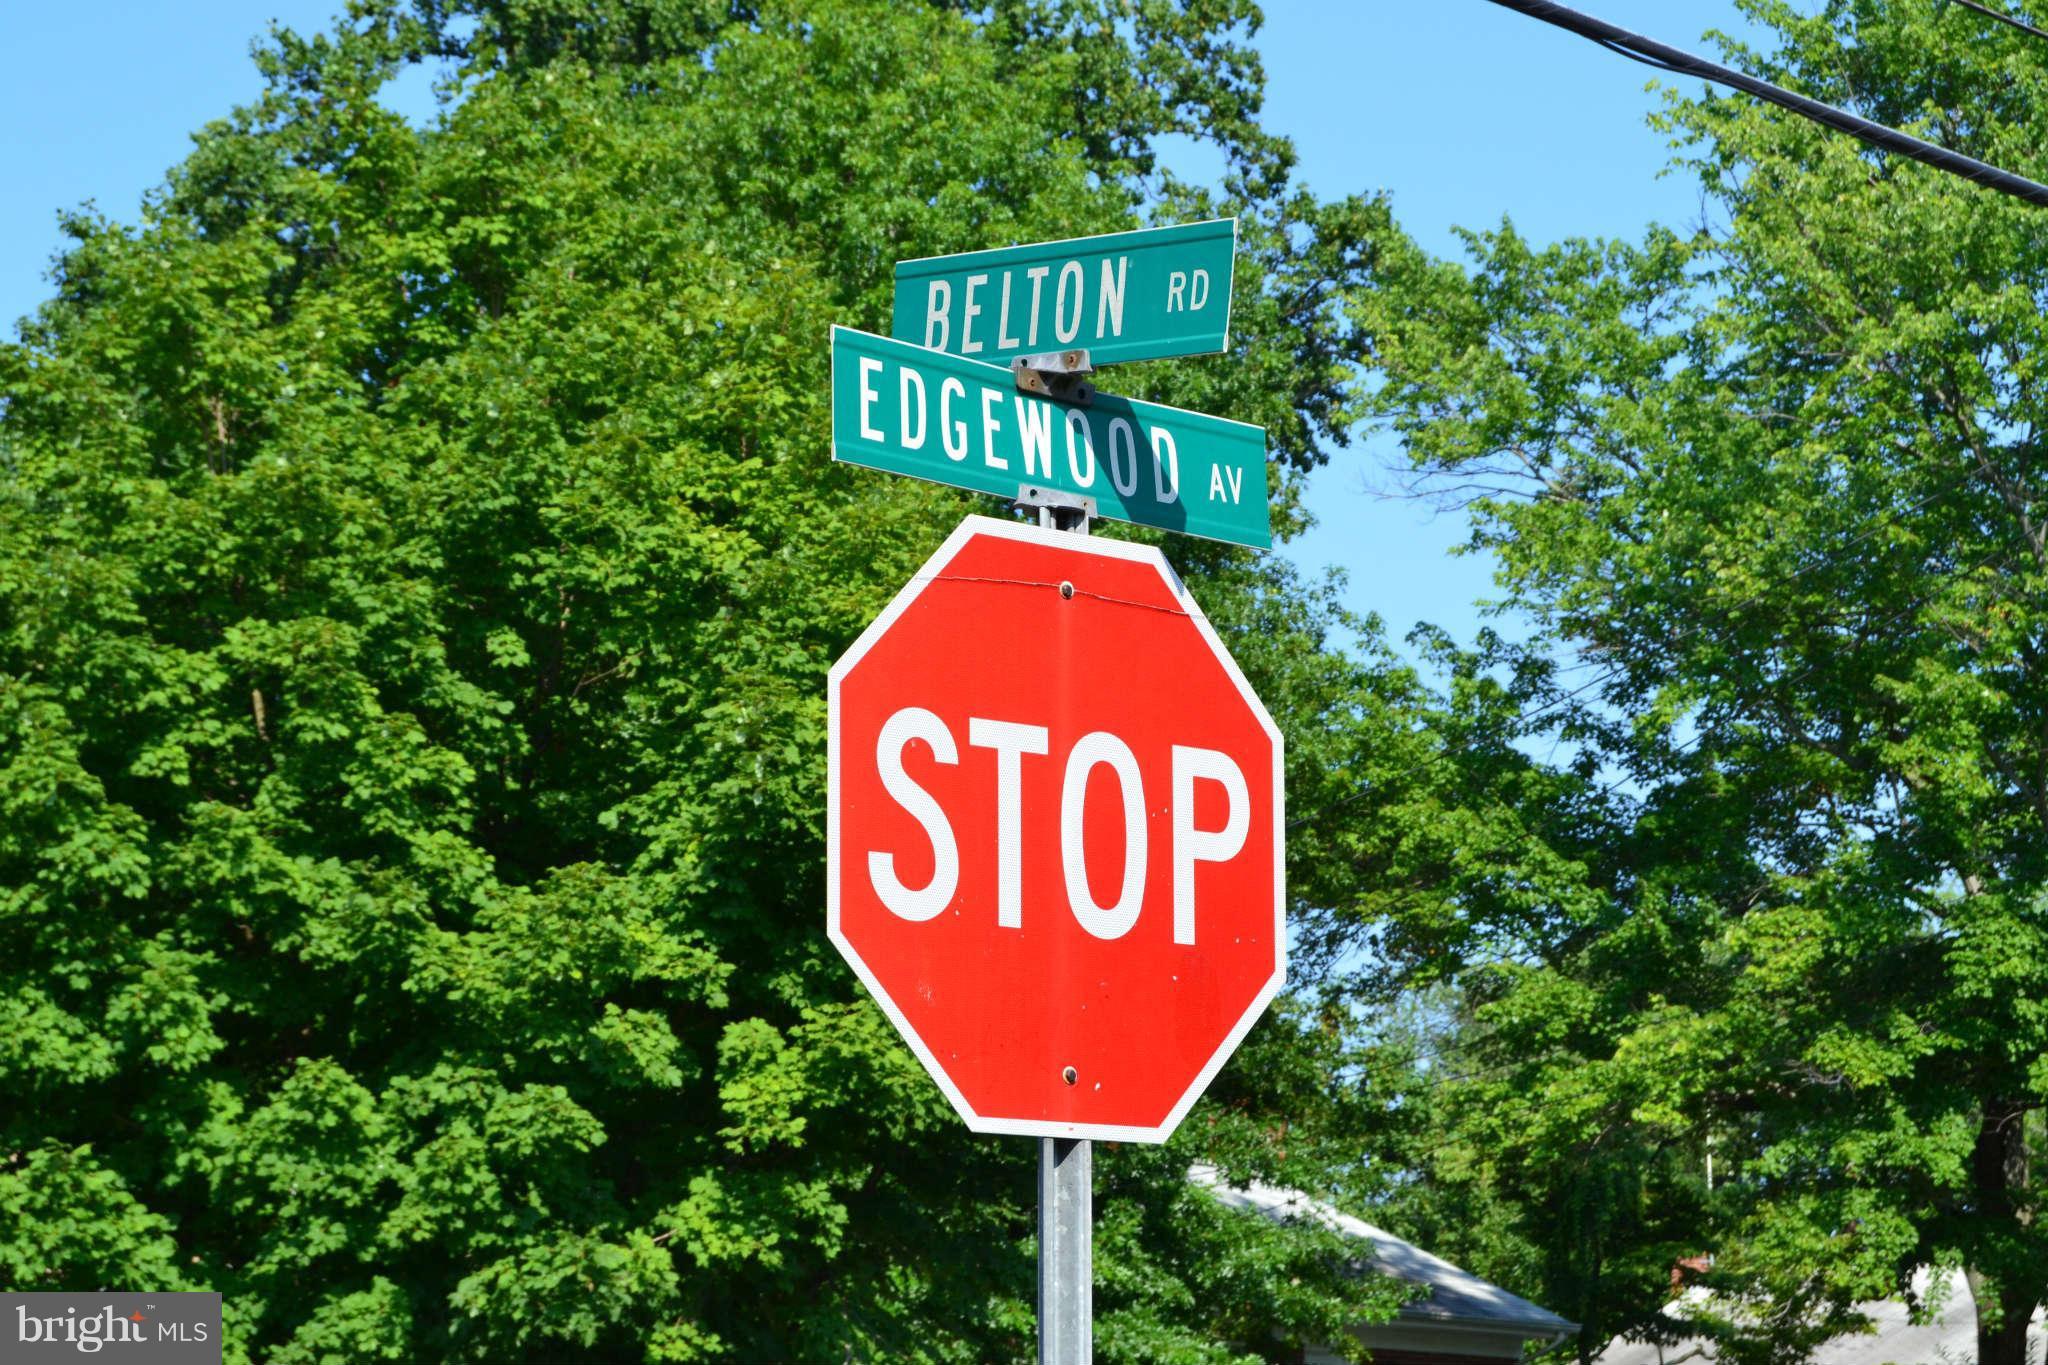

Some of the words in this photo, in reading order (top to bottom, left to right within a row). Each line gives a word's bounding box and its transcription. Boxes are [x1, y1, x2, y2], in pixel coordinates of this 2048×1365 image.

[924, 256, 1127, 354] BELTON
[1167, 269, 1209, 312] RD
[859, 356, 1178, 504] EDGEWOOD
[1209, 463, 1243, 505] AV
[867, 706, 1250, 945] STOP
